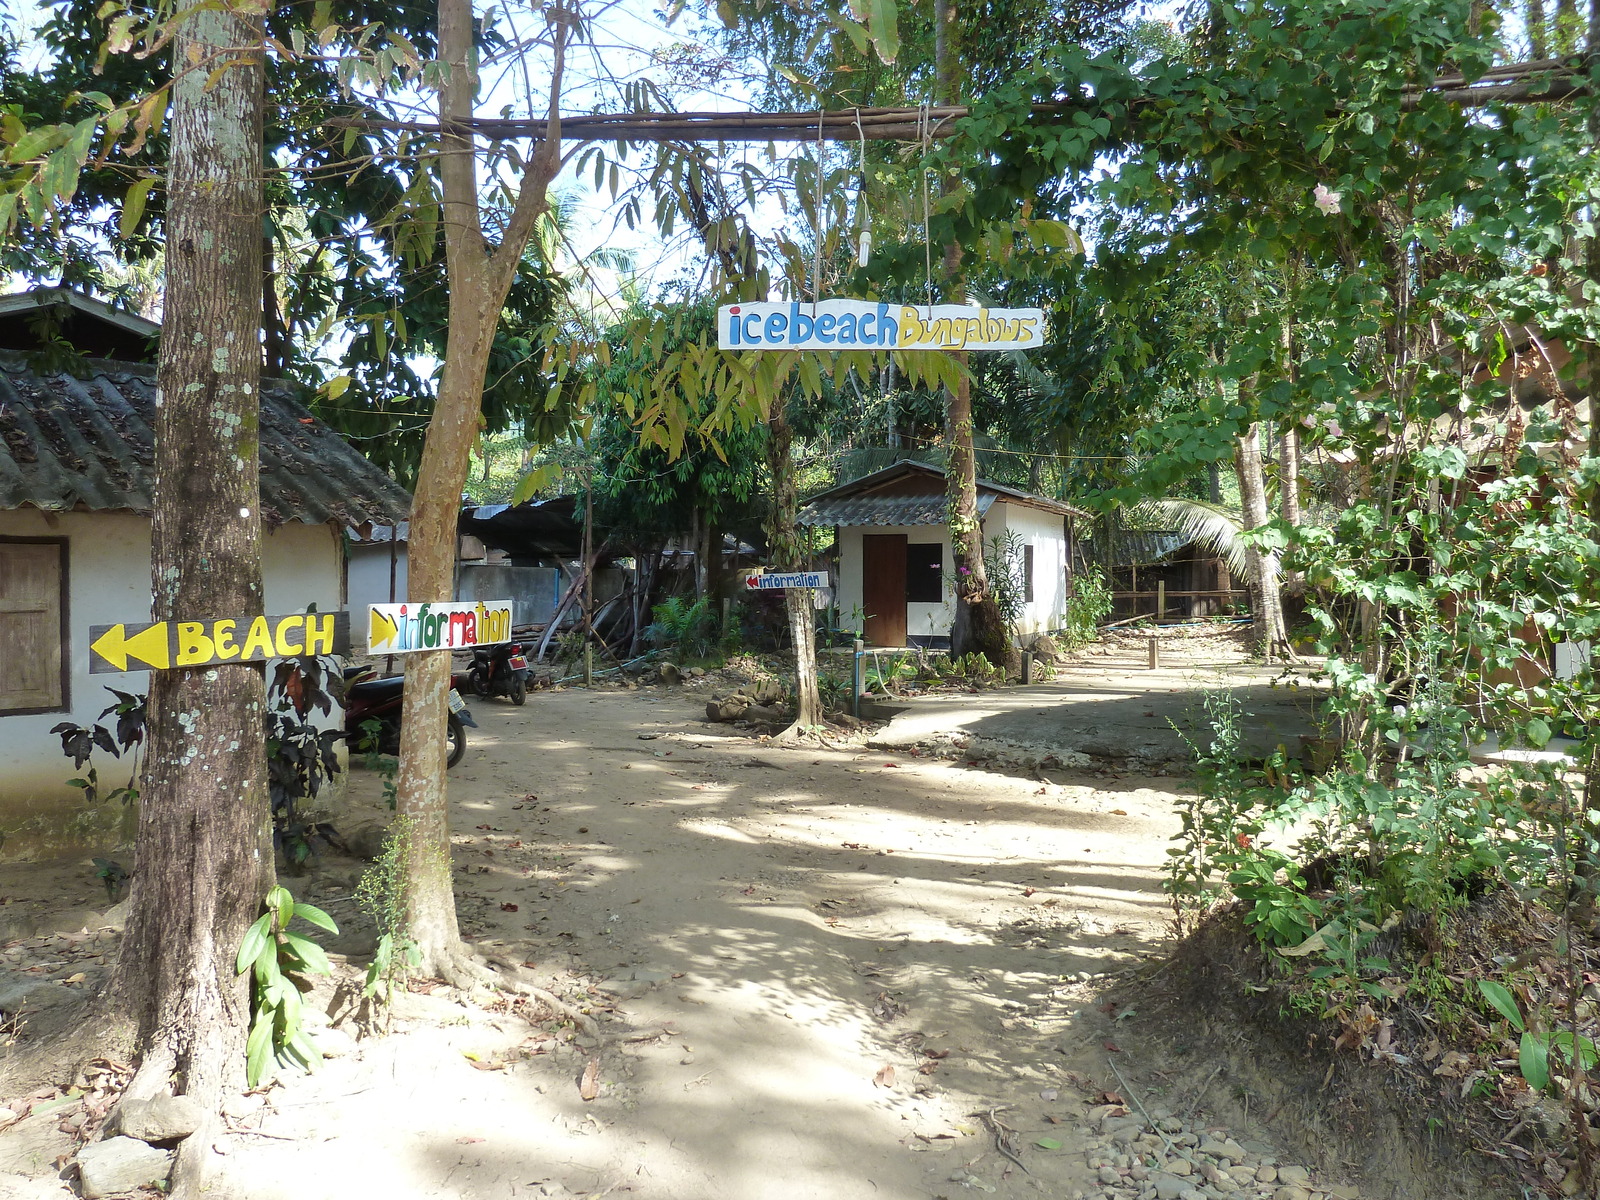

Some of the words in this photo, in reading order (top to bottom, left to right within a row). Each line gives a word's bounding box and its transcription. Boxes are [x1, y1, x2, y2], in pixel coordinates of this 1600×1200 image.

[729, 303, 897, 347] icebeach
[898, 304, 1037, 350] Bungalows
[758, 573, 820, 589] information
[176, 614, 335, 666] BEACH
[398, 601, 511, 650] information
